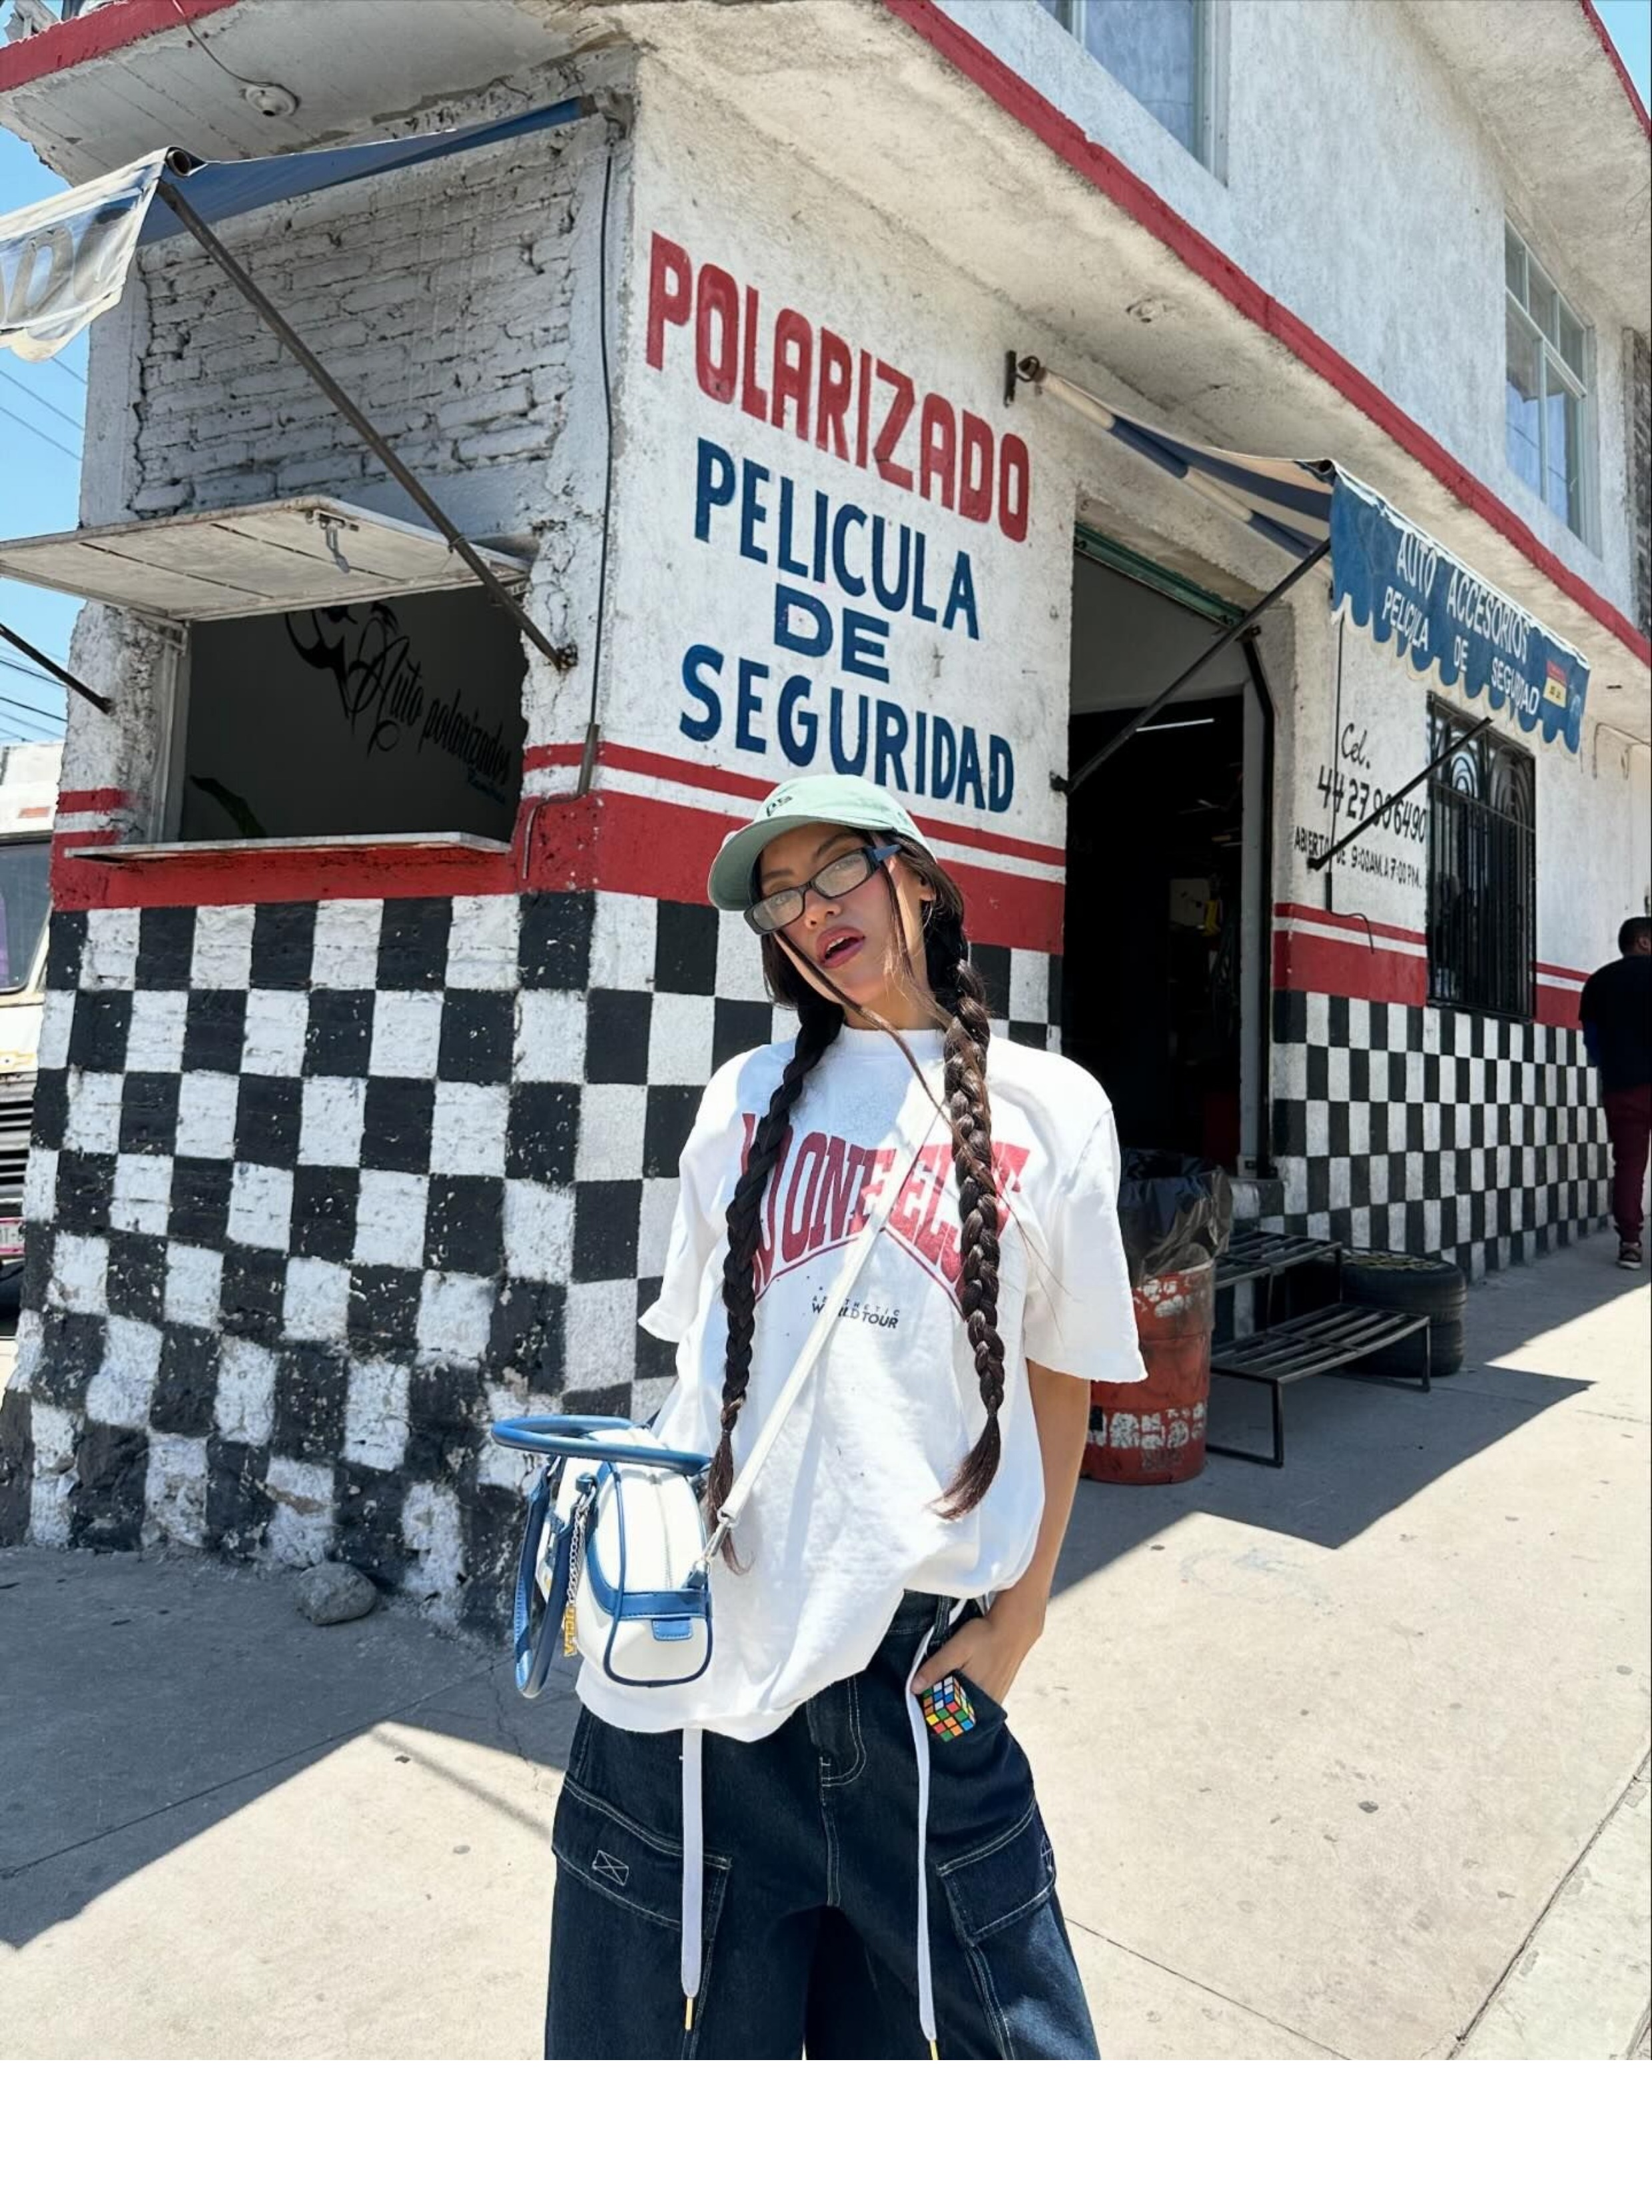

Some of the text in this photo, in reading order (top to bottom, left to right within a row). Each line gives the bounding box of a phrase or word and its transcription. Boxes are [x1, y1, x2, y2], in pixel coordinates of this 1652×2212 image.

[645, 231, 1030, 543] POLARIZADO
[694, 437, 980, 640] PELICULA
[774, 582, 890, 684] DE
[1396, 531, 1530, 665] AUTO ACCESORIOS
[348, 618, 424, 760] Auto
[1453, 635, 1469, 672] DE
[679, 644, 1015, 814] SEGURIDAD
[1341, 723, 1370, 769] Cel.
[1294, 826, 1330, 857] ABIERTO
[812, 1295, 900, 1317] AETHETIC
[812, 1302, 899, 1329] WLD TOUR
